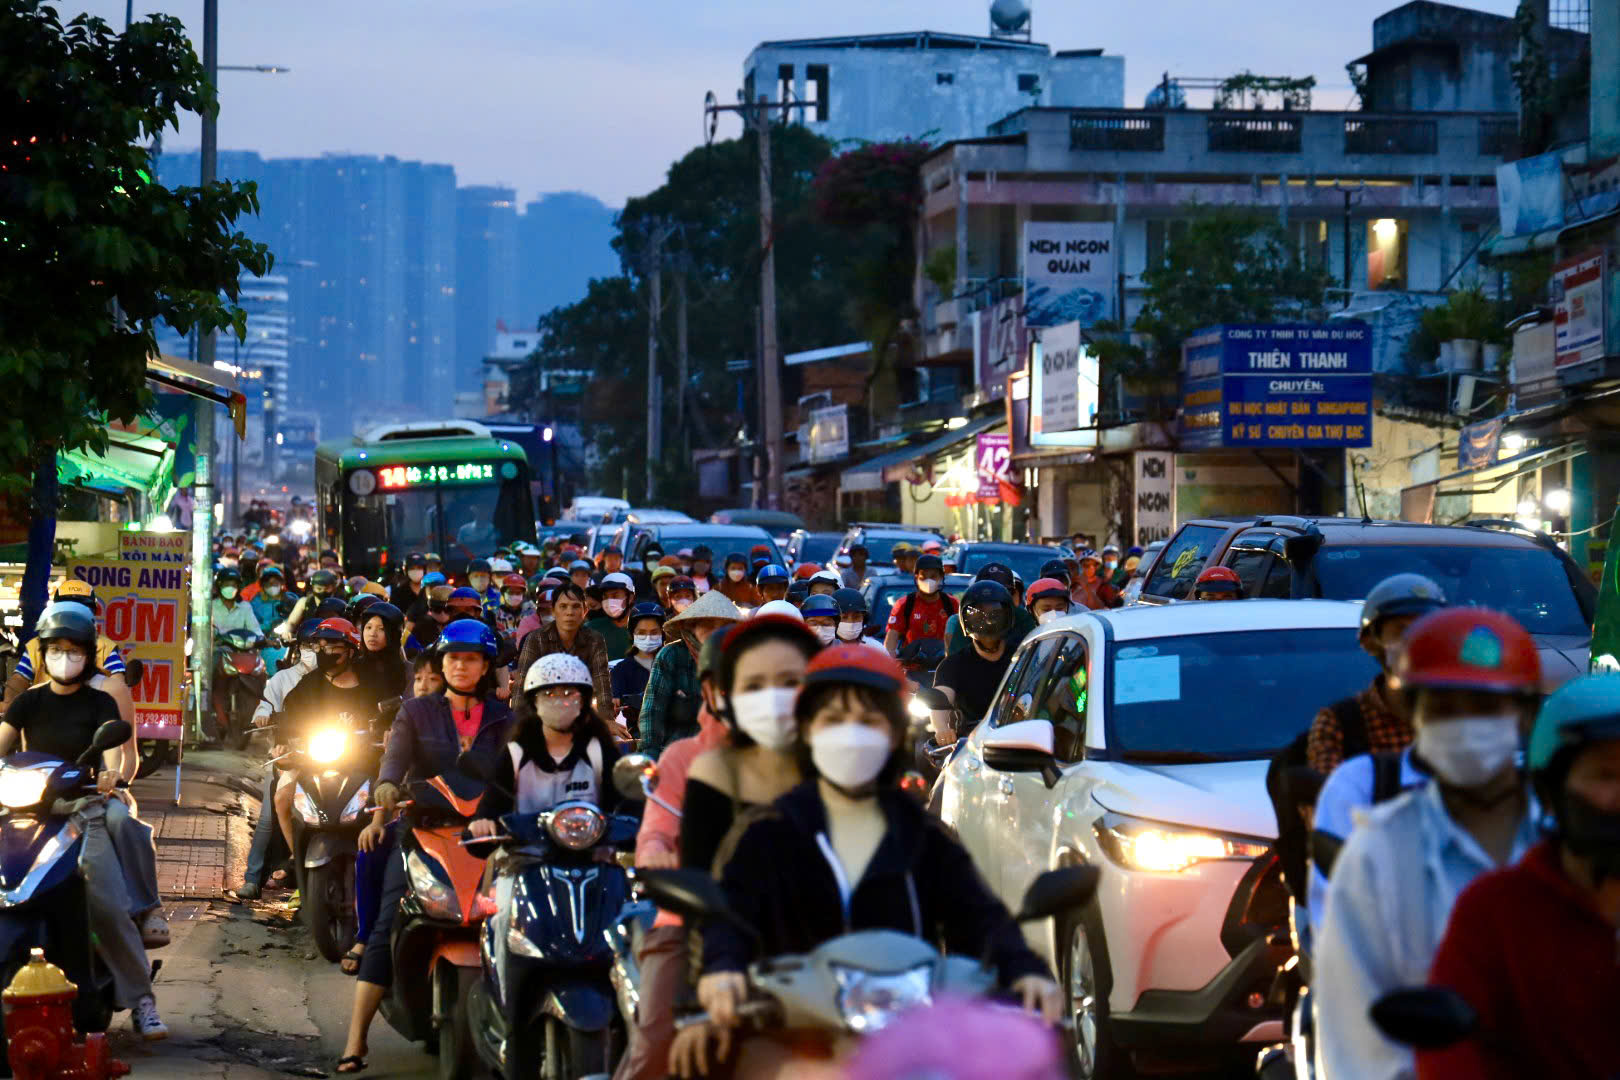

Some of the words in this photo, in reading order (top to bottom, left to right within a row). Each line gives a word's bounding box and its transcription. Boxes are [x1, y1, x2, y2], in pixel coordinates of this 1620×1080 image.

[1029, 240, 1060, 254] NEM
[1066, 240, 1110, 254] NGON
[1248, 348, 1290, 369] THIÊN
[1299, 352, 1347, 369] THANH
[1269, 378, 1324, 392] CHUYÊN:
[1142, 457, 1166, 478] NEM
[1138, 492, 1170, 512] NGON
[160, 537, 183, 547] BAO
[74, 565, 131, 587] SONG
[137, 567, 182, 589] ANH
